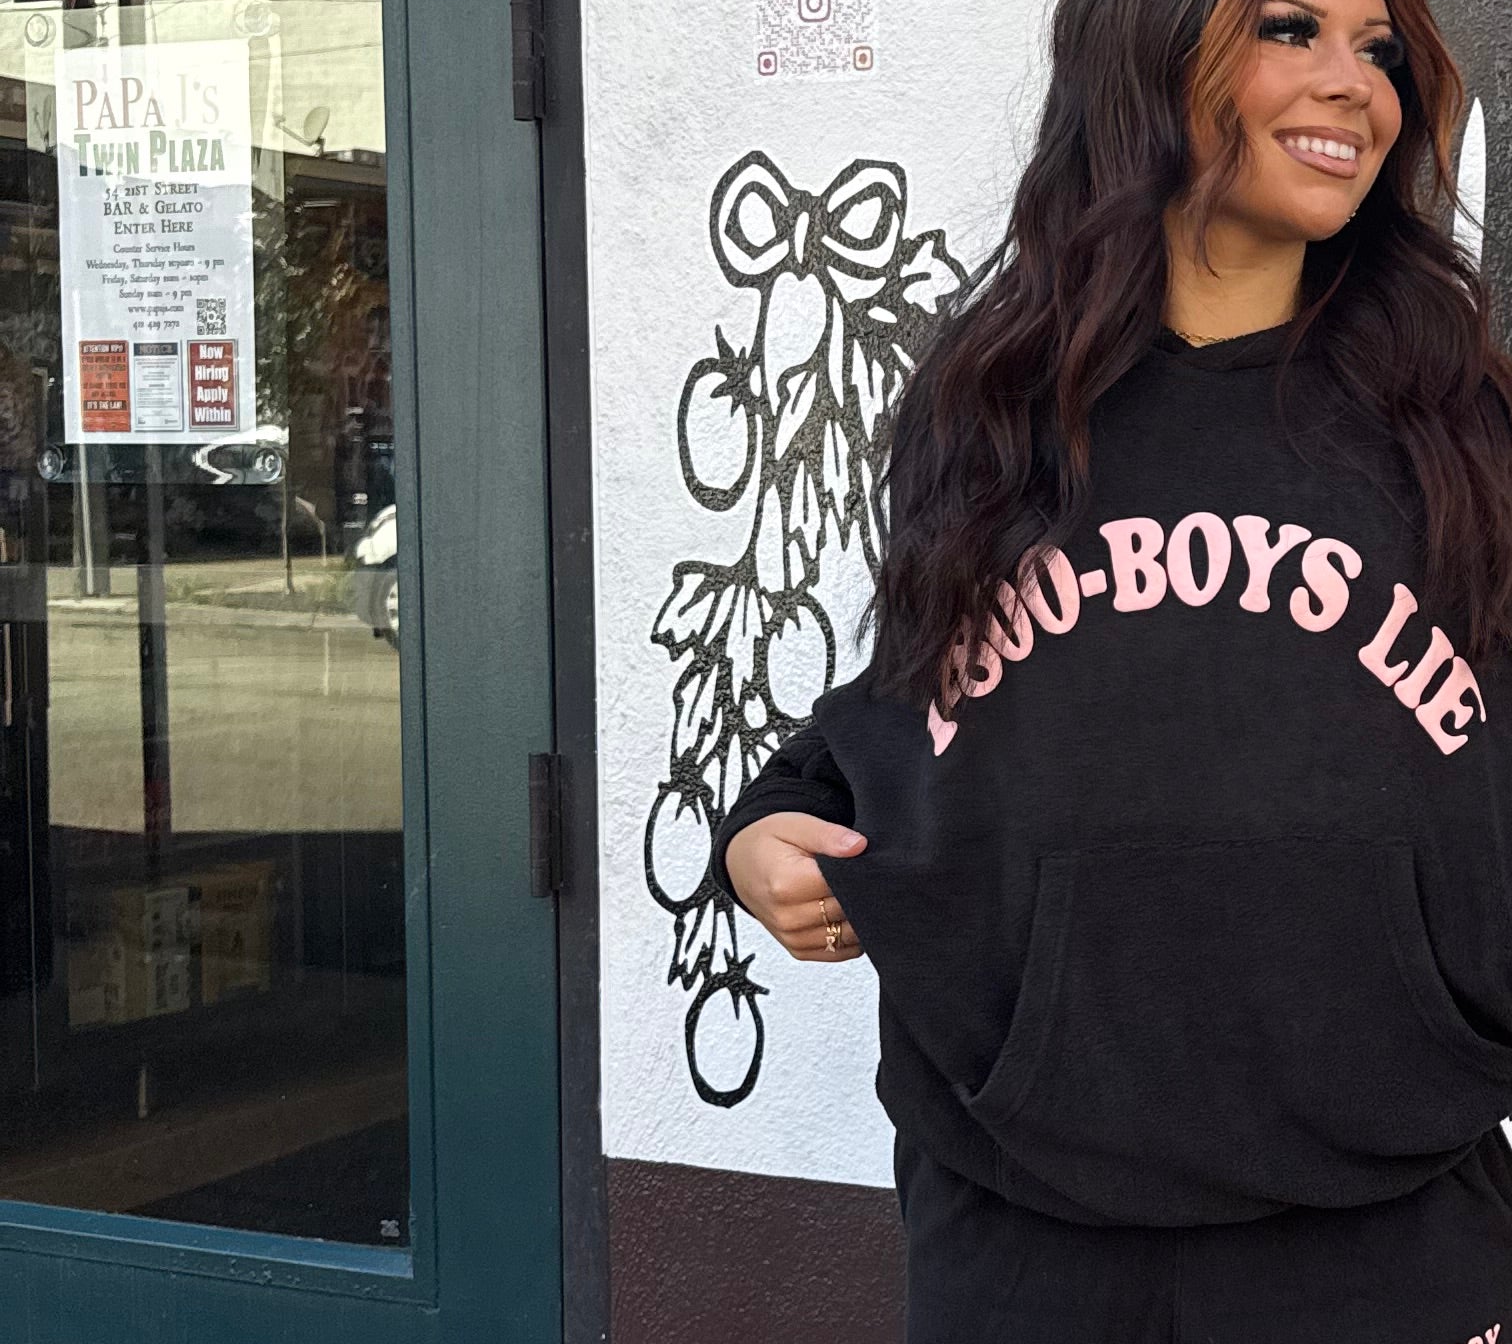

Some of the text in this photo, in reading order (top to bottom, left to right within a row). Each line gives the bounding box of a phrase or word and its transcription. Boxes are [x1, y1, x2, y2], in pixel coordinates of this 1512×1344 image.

[73, 130, 225, 177] TWIN PLAZA
[105, 188, 118, 201] 54
[155, 181, 199, 196] STREET
[104, 201, 203, 216] BAR & GELATO
[114, 219, 193, 234] ENTER HERE
[199, 343, 224, 360] Now
[194, 365, 229, 382] Hiring
[196, 386, 228, 403] Apply
[194, 406, 231, 423] Within
[1358, 583, 1487, 756] LIE
